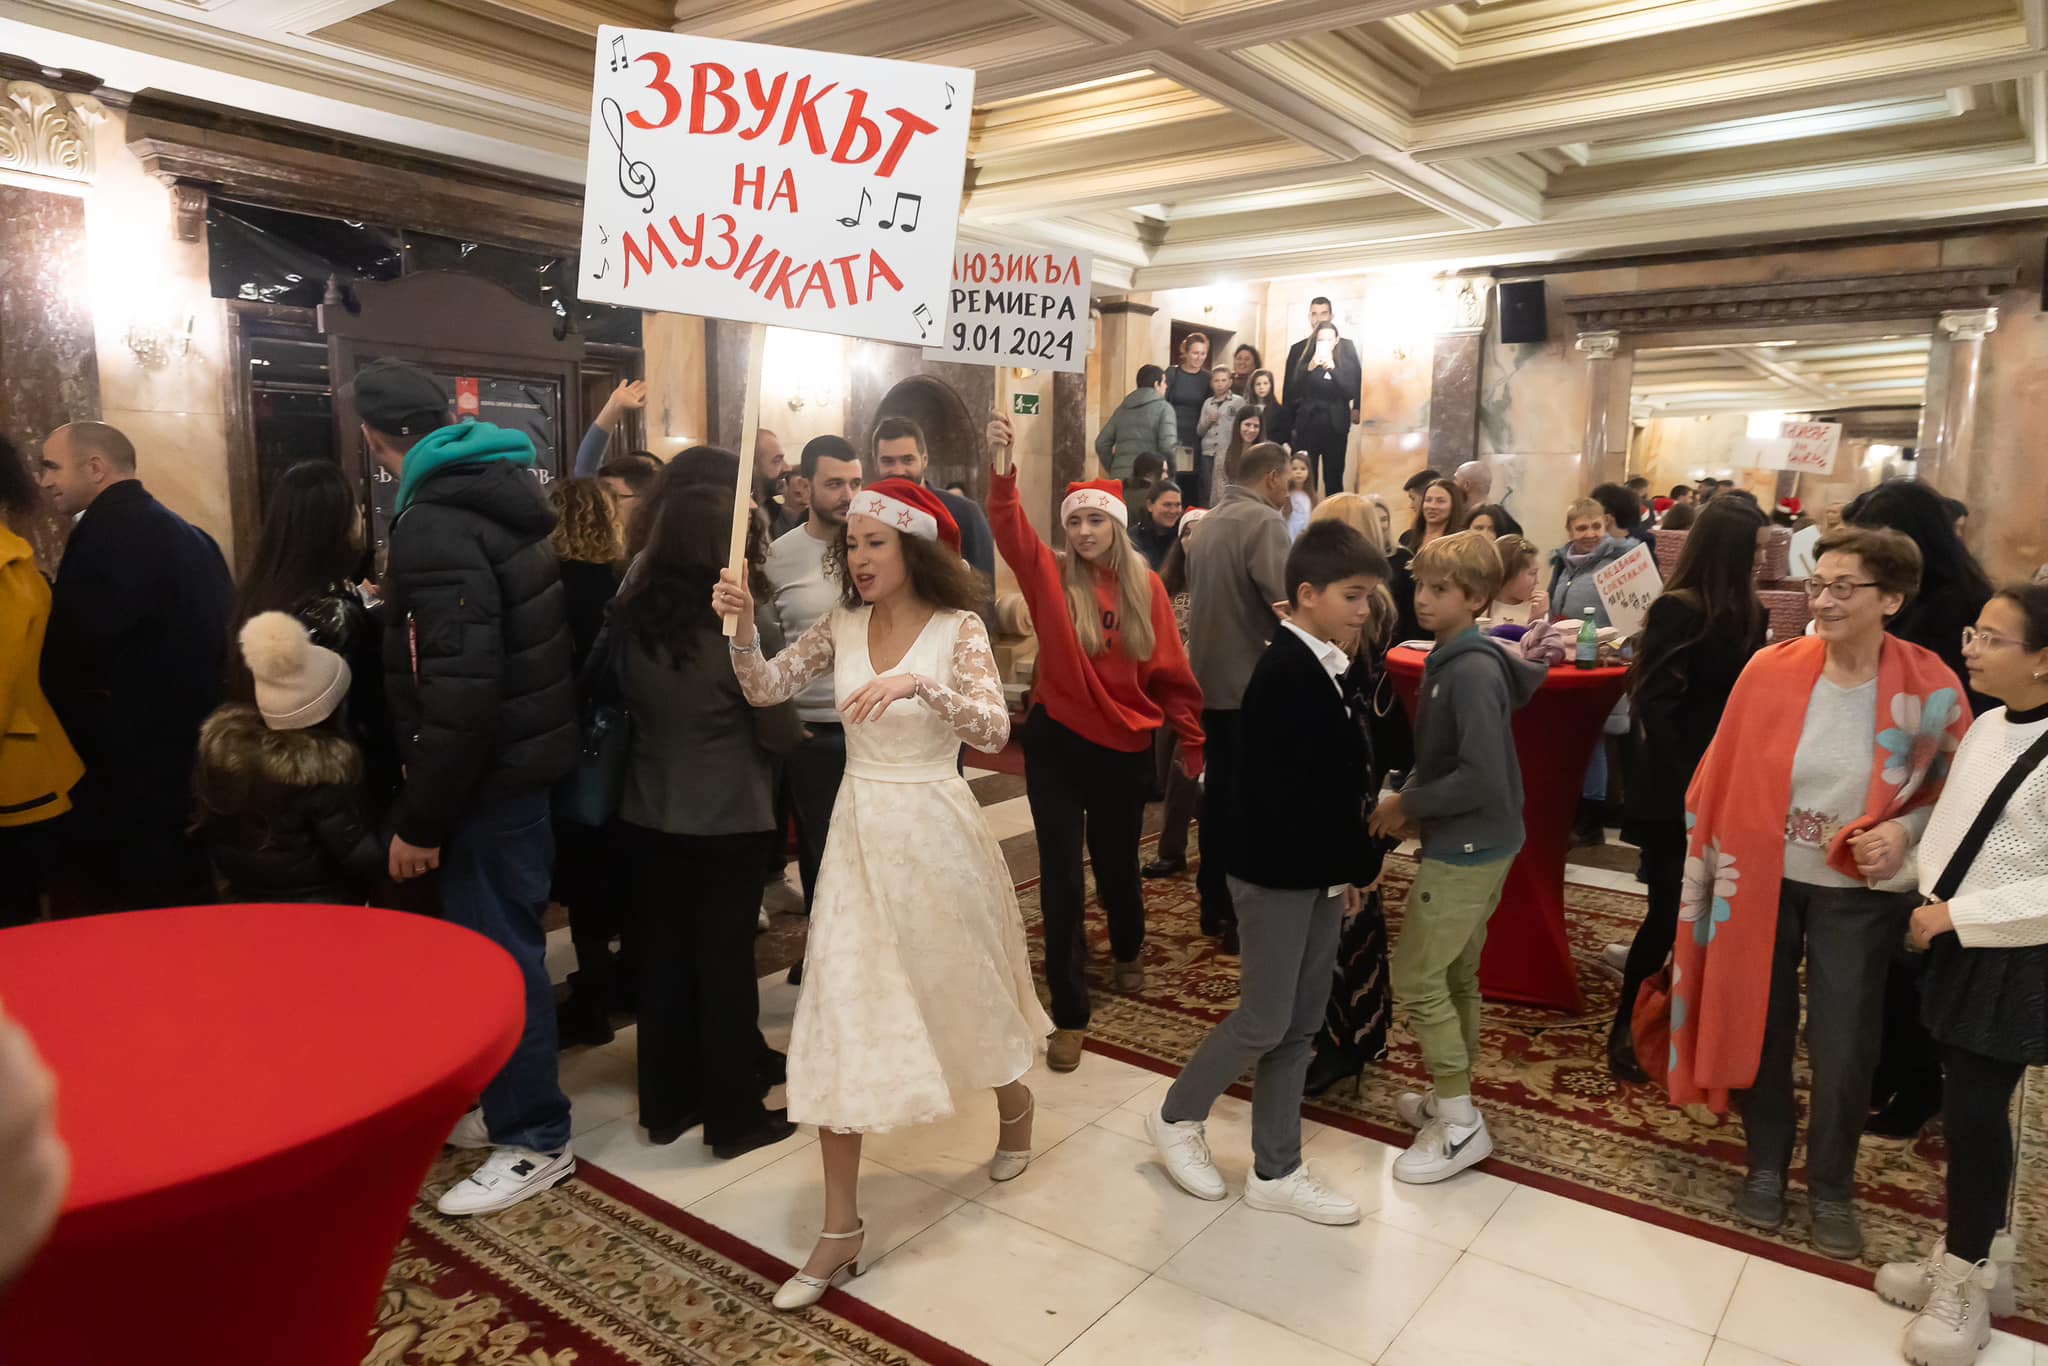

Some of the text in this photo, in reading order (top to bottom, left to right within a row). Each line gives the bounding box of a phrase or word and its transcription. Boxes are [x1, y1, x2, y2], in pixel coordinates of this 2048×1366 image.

[625, 51, 940, 178] ЗВУКЪТ
[732, 163, 798, 213] НА
[623, 213, 904, 309] МУЗИКАТА
[951, 288, 1076, 321] РЕМИЕРА
